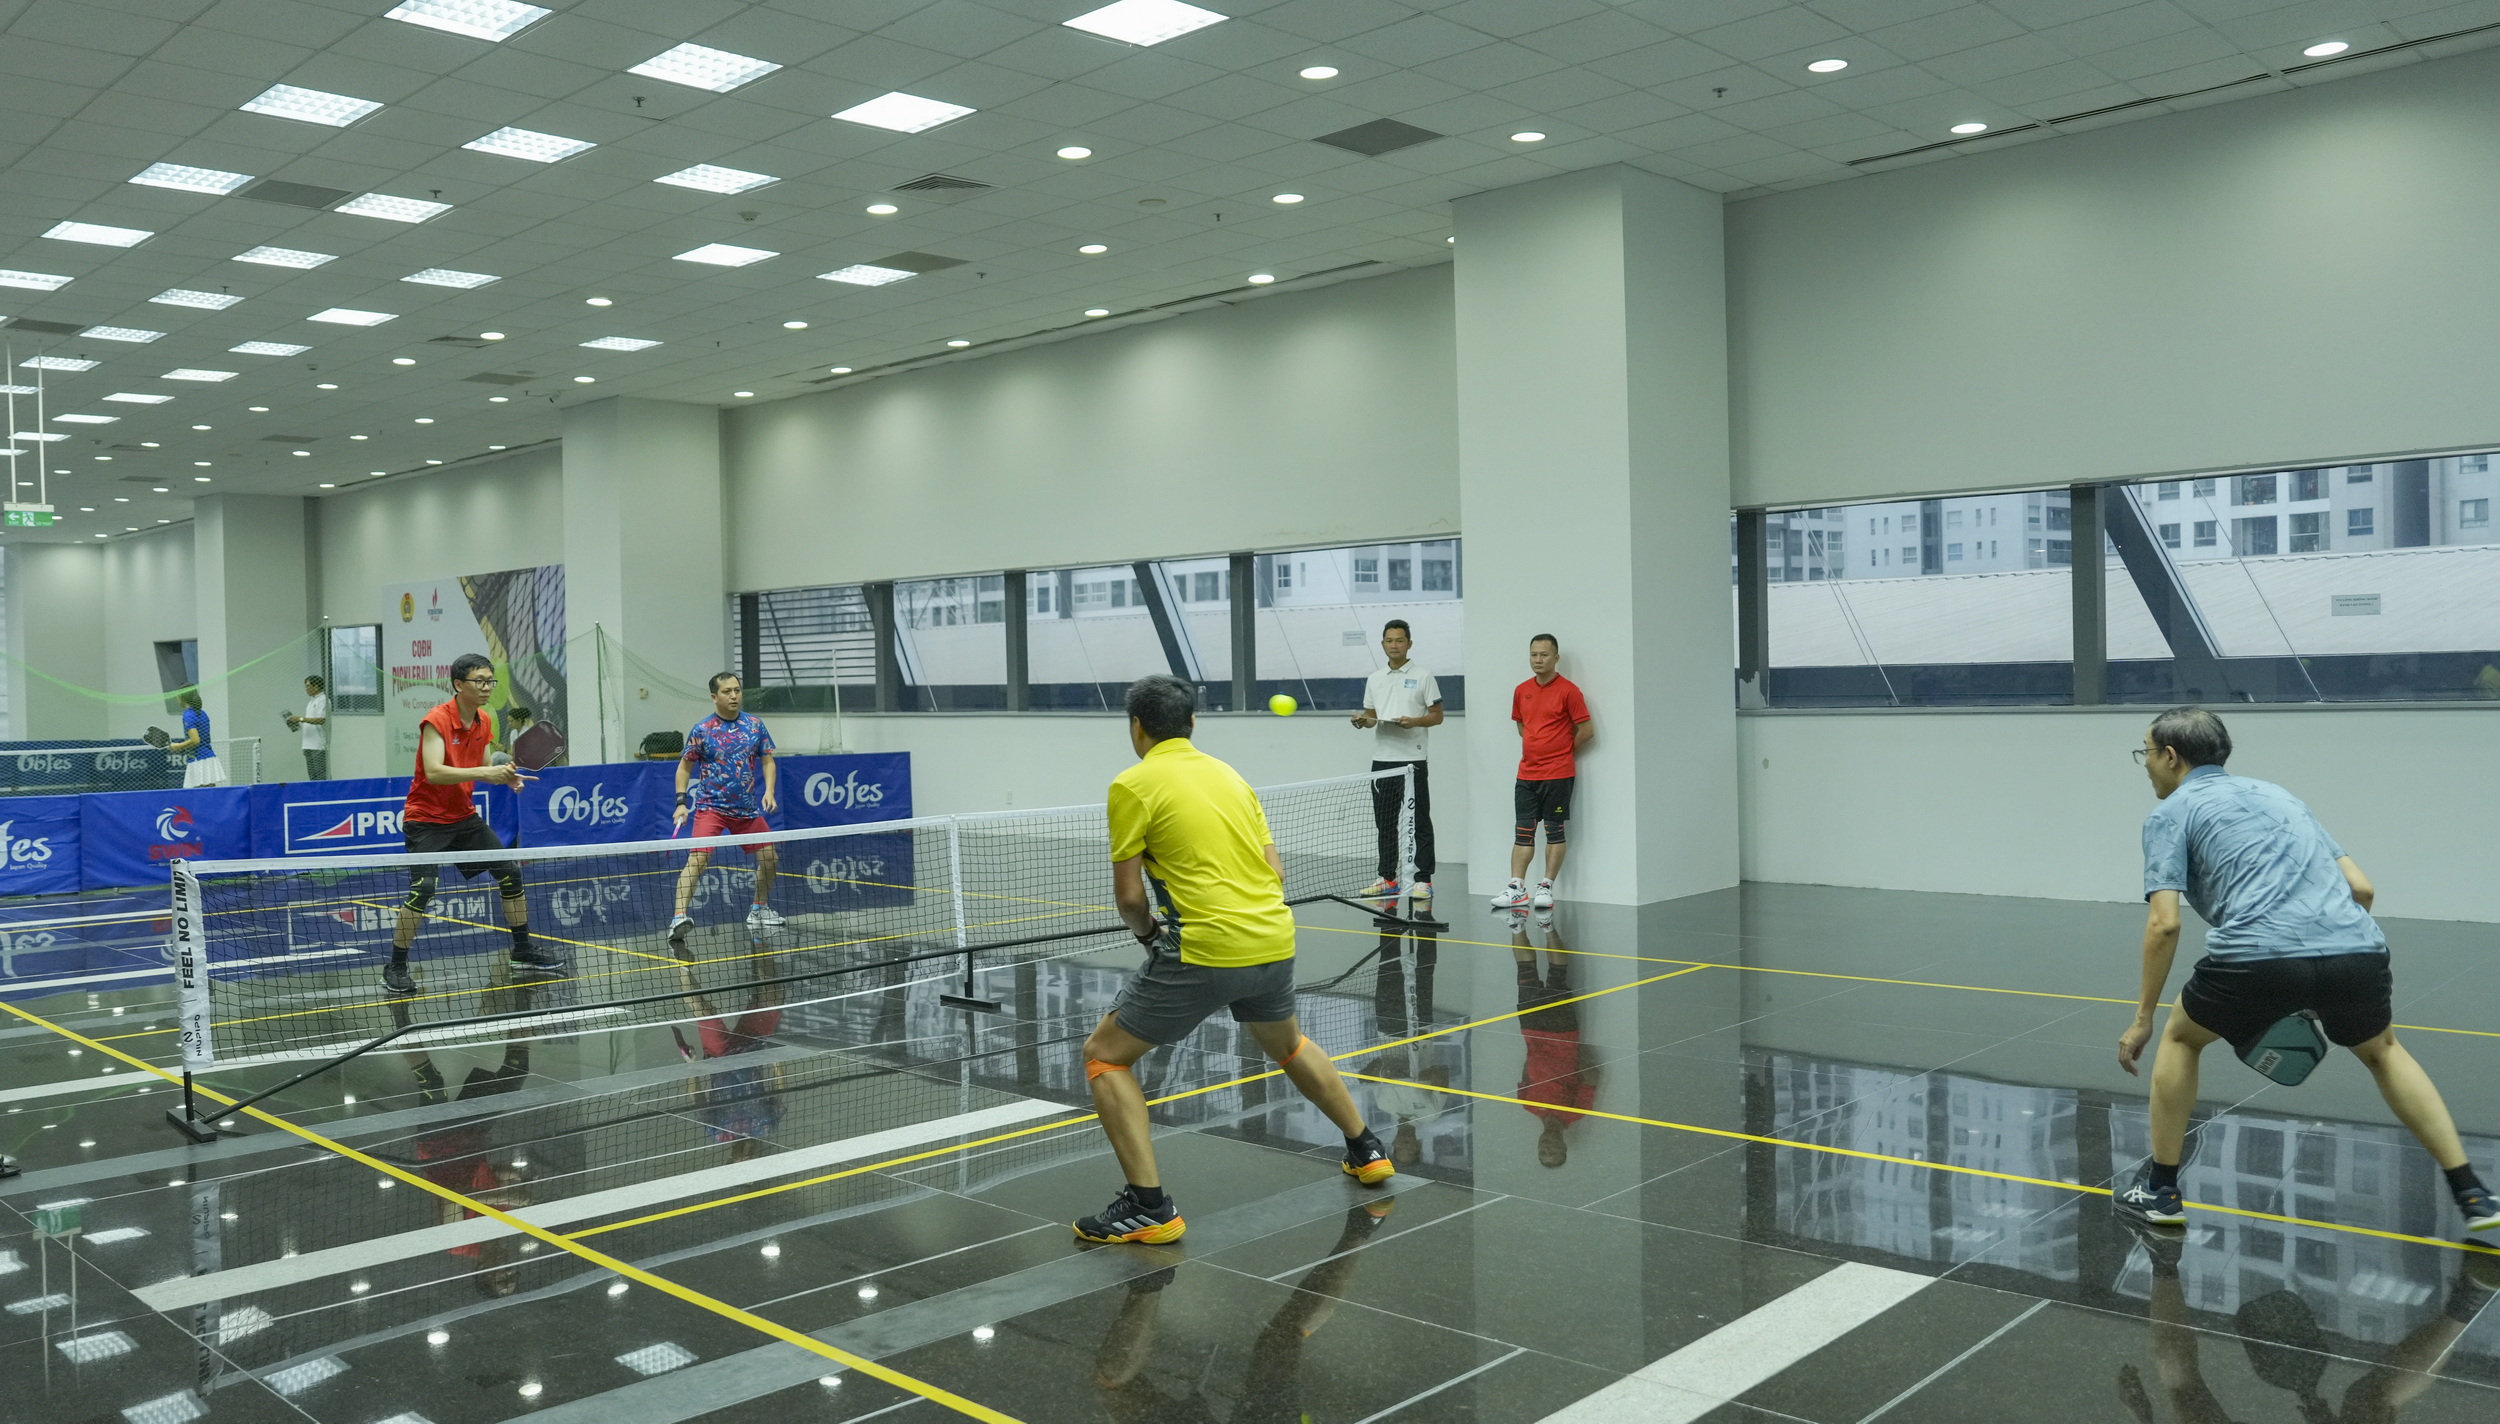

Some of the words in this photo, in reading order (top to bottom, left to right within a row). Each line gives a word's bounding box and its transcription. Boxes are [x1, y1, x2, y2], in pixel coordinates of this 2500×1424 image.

[17, 754, 72, 773] Obfes
[95, 751, 148, 773] Obfes
[548, 783, 629, 826] Obfes
[803, 770, 884, 810] Obfes
[0, 820, 52, 869] fes
[149, 842, 202, 860] SWIN
[177, 917, 190, 942] NO
[181, 947, 195, 989] FEEL
[194, 1014, 203, 1057] NIUPIPO
